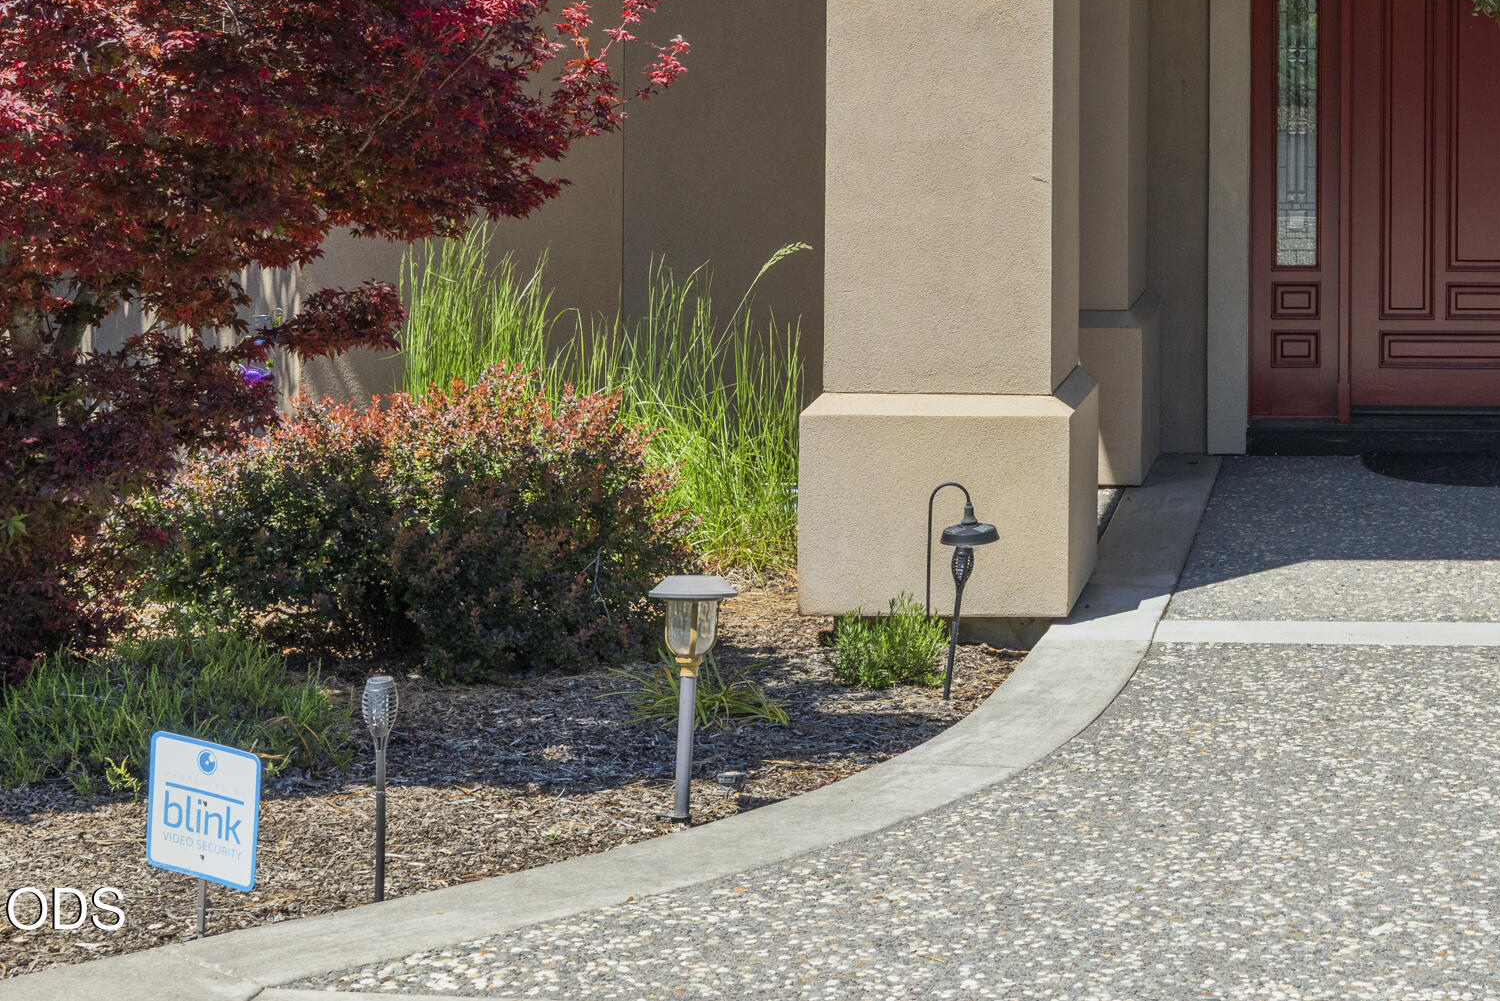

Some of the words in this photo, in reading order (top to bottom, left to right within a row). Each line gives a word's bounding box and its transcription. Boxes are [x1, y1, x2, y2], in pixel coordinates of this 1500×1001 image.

[163, 790, 242, 845] blink
[163, 831, 194, 848] VIDEO
[196, 839, 242, 860] SECURITY
